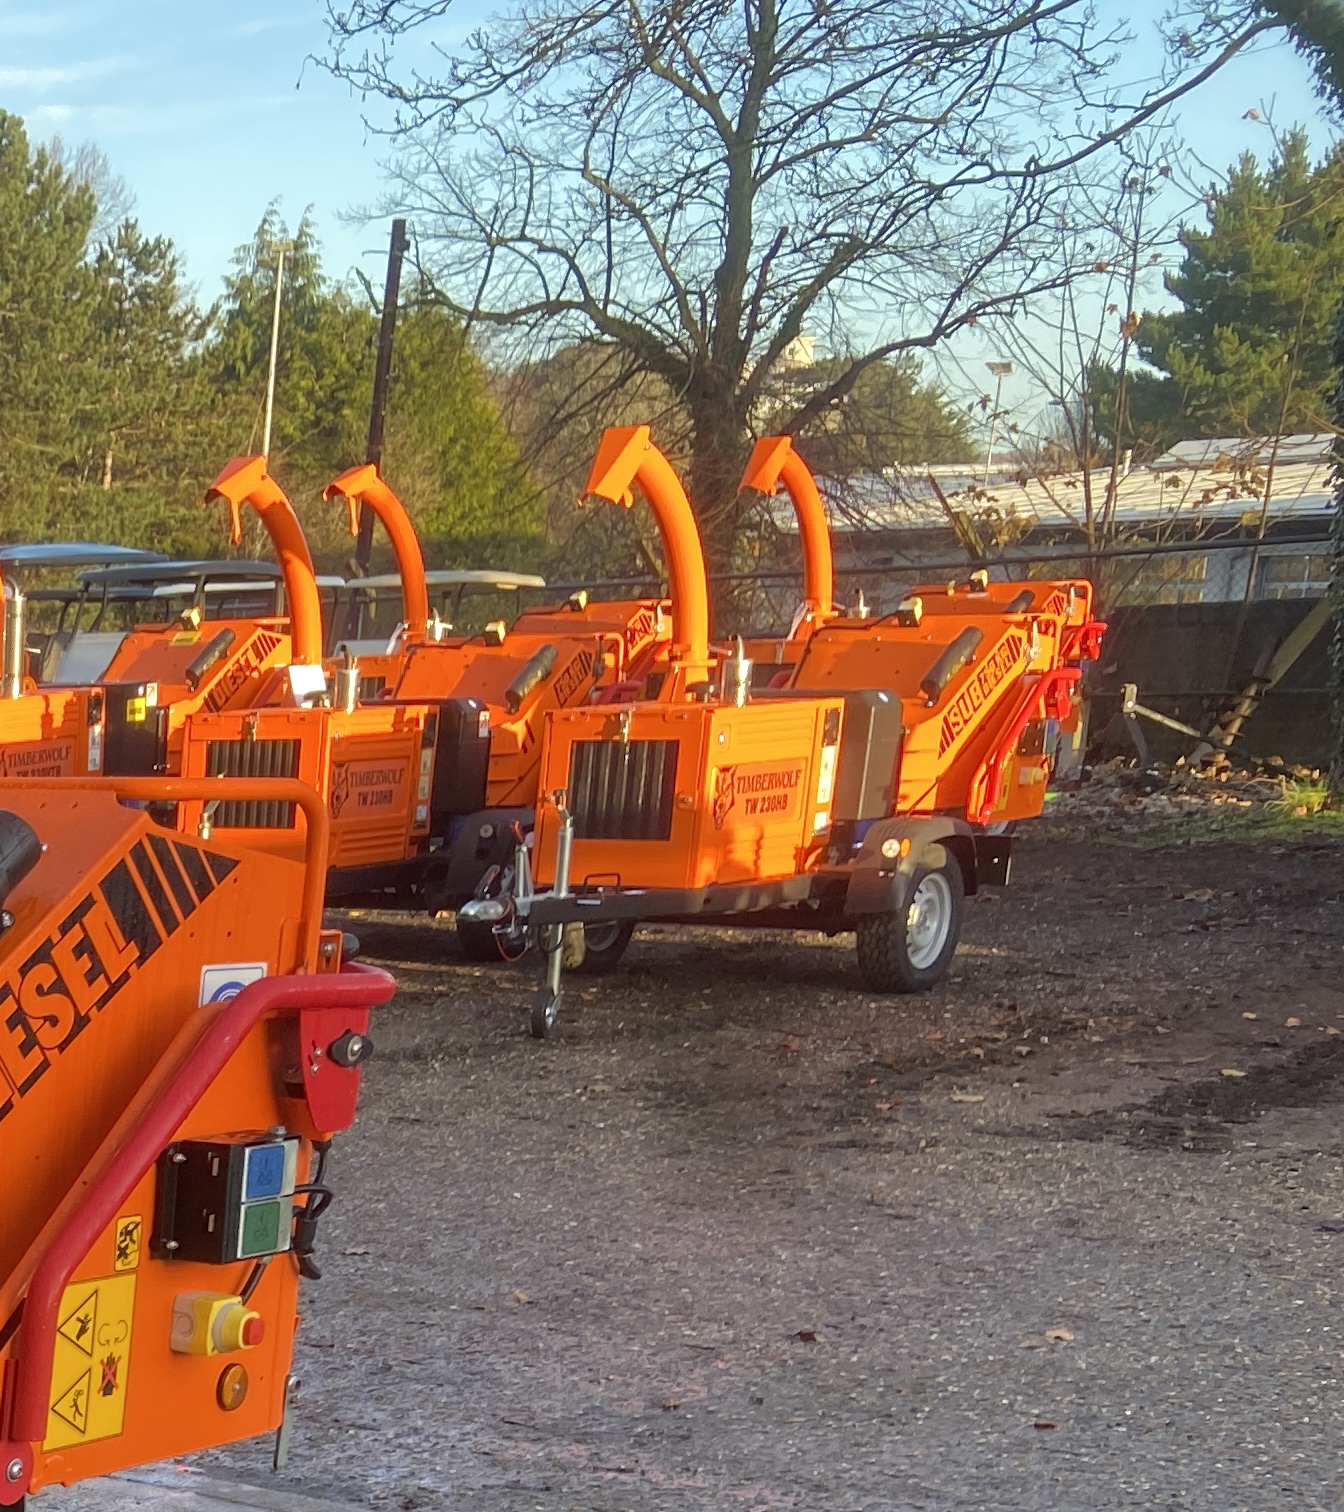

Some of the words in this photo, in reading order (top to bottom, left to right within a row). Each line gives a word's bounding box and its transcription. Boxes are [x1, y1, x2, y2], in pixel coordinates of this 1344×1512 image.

[947, 680, 983, 735] SUB
[7, 744, 72, 769] TIMBERWOLF
[350, 767, 406, 787] TIMBERWOLF
[737, 769, 803, 795] TIMBERWOLF
[358, 791, 369, 807] TW
[745, 798, 758, 816] TW
